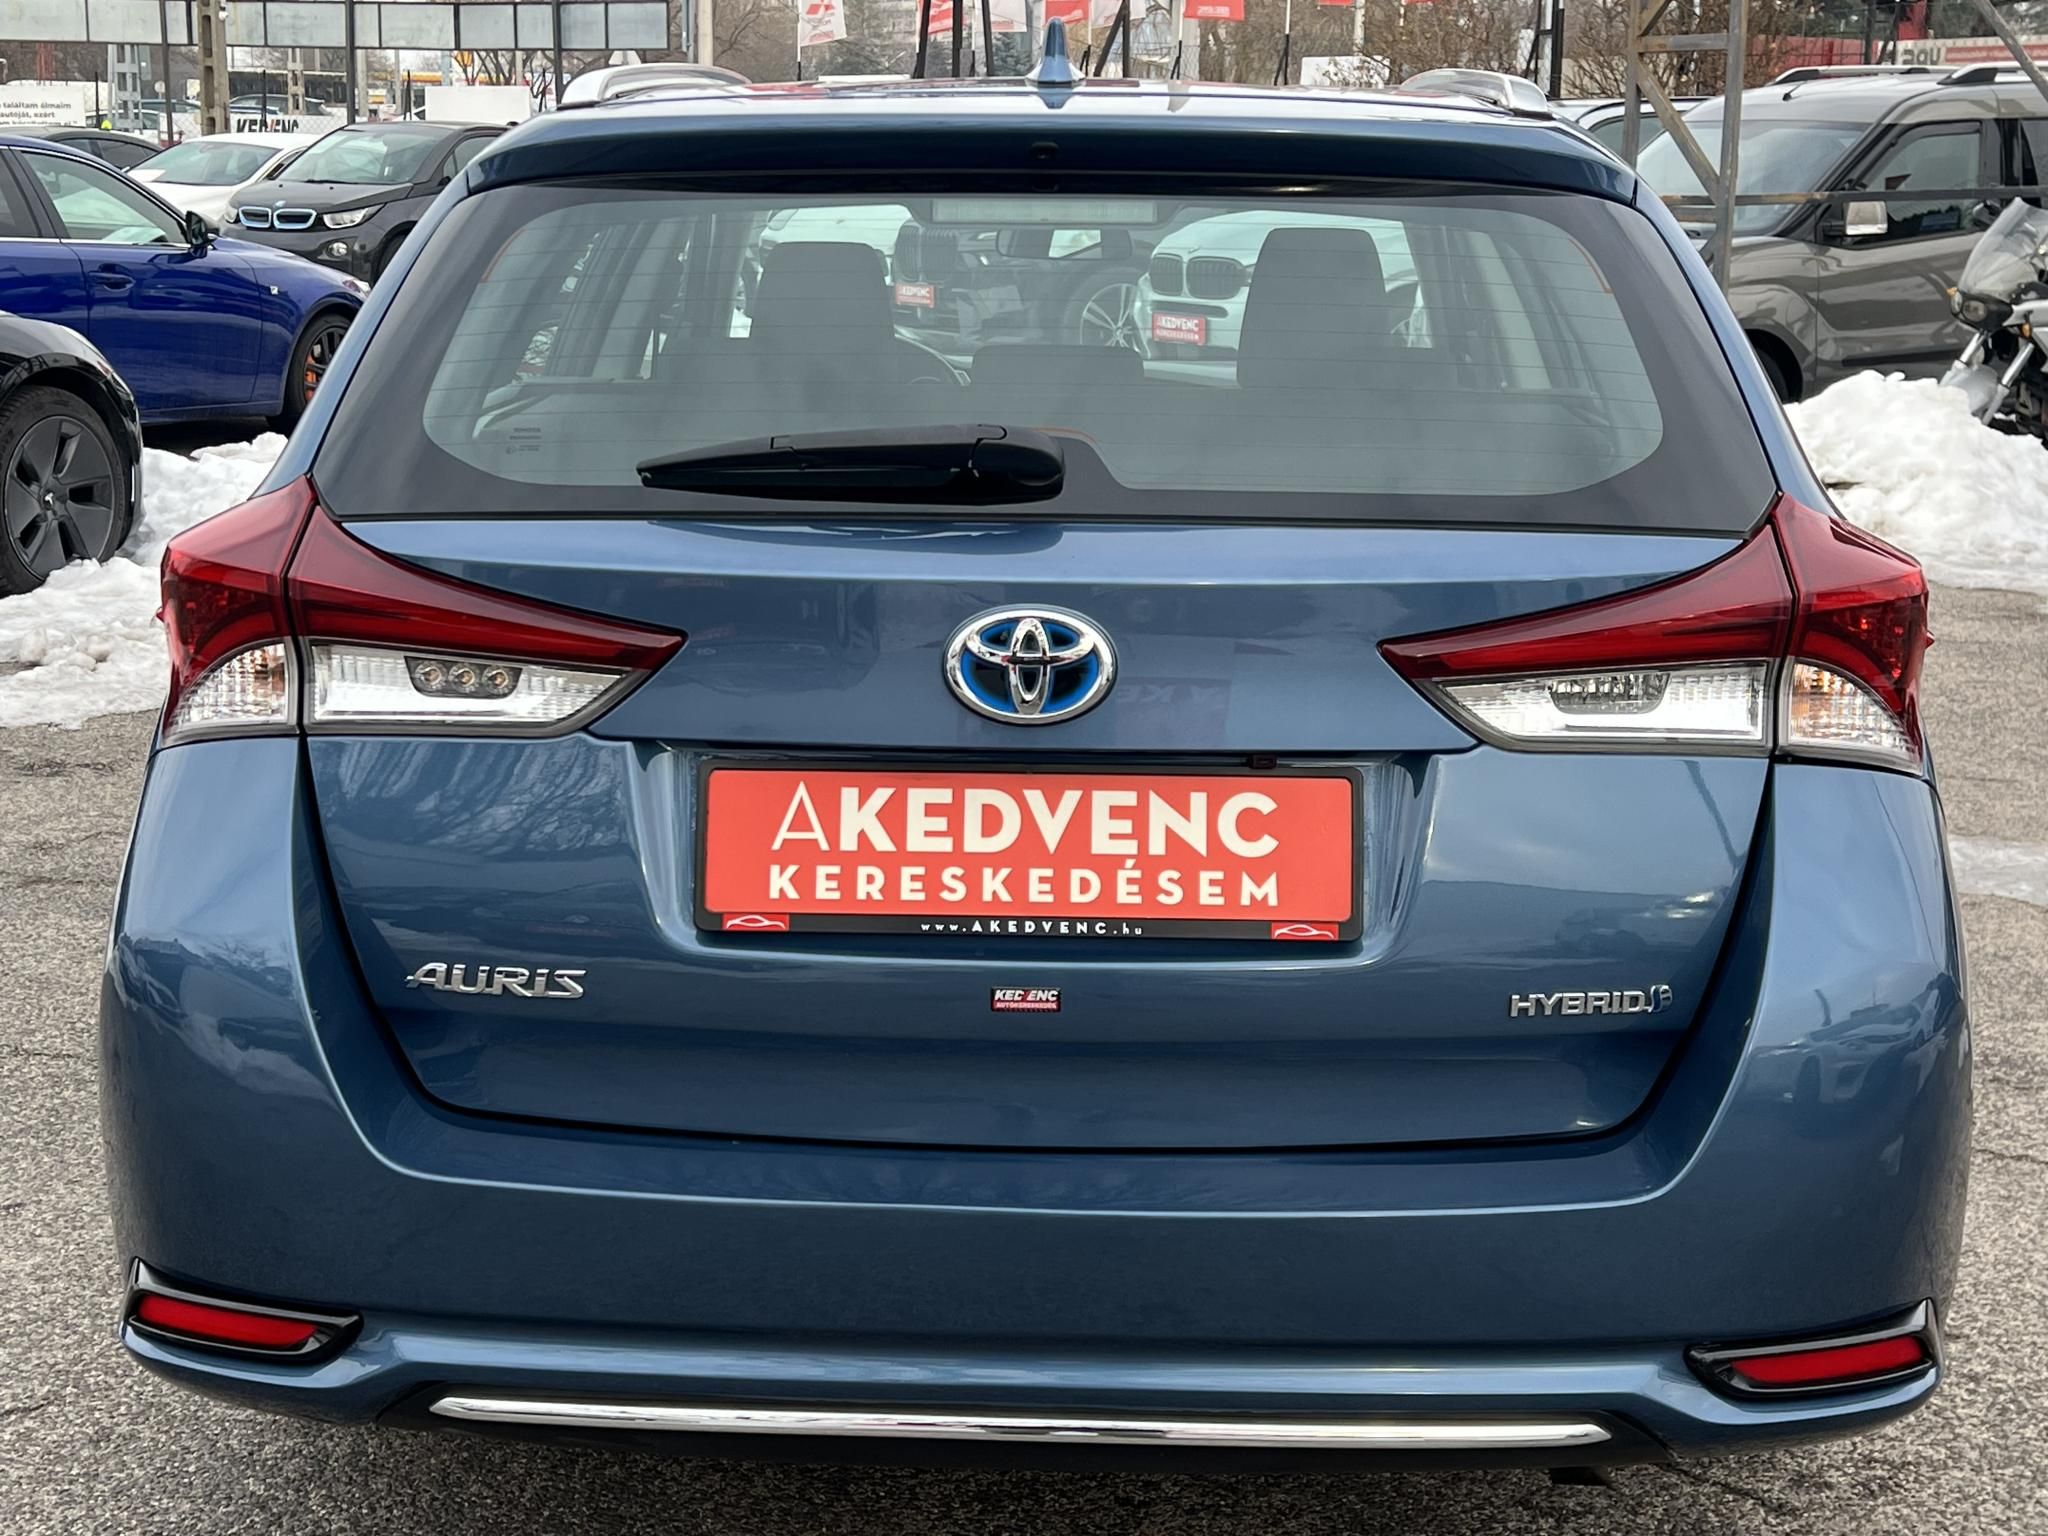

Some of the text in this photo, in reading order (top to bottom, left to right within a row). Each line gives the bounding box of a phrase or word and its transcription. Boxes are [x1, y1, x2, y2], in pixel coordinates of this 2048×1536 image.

[768, 859, 1279, 907] KERESKEDÉSEM
[921, 920, 1143, 935] www.AKEDVENC.hu
[1511, 991, 1646, 1017] HYBRID
